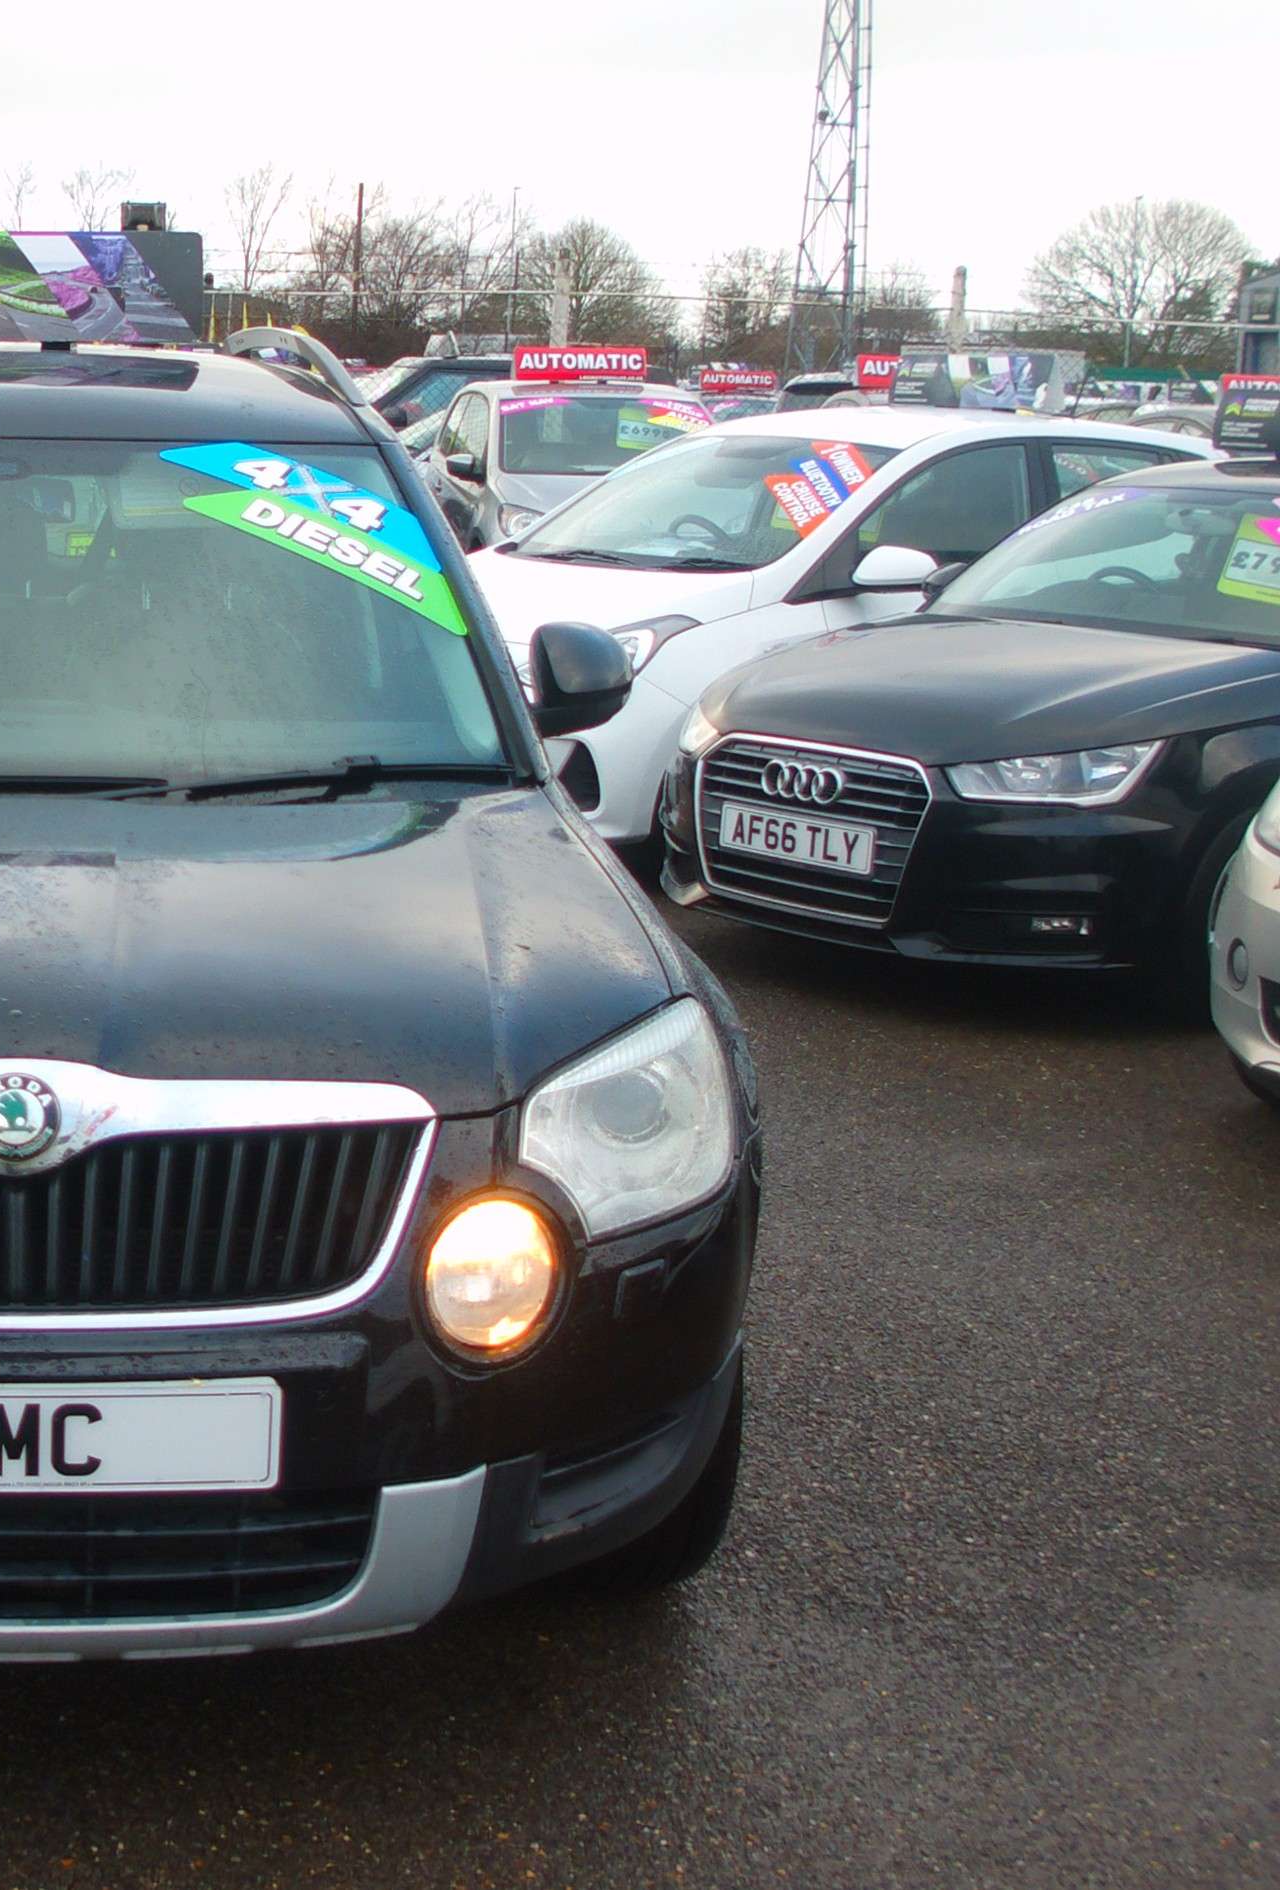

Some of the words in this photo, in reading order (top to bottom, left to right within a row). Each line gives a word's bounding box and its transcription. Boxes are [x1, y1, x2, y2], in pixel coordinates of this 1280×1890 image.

[519, 353, 643, 370] AUTOMATIC
[702, 373, 773, 385] AUTOMATIC
[799, 459, 842, 508] BLUETOOTH
[828, 450, 866, 486] OWNER
[772, 482, 812, 528] CONTROL
[790, 480, 826, 518] CRUISE
[239, 498, 424, 602] DIESEL
[731, 811, 797, 854] AF66
[805, 824, 860, 865] TLY
